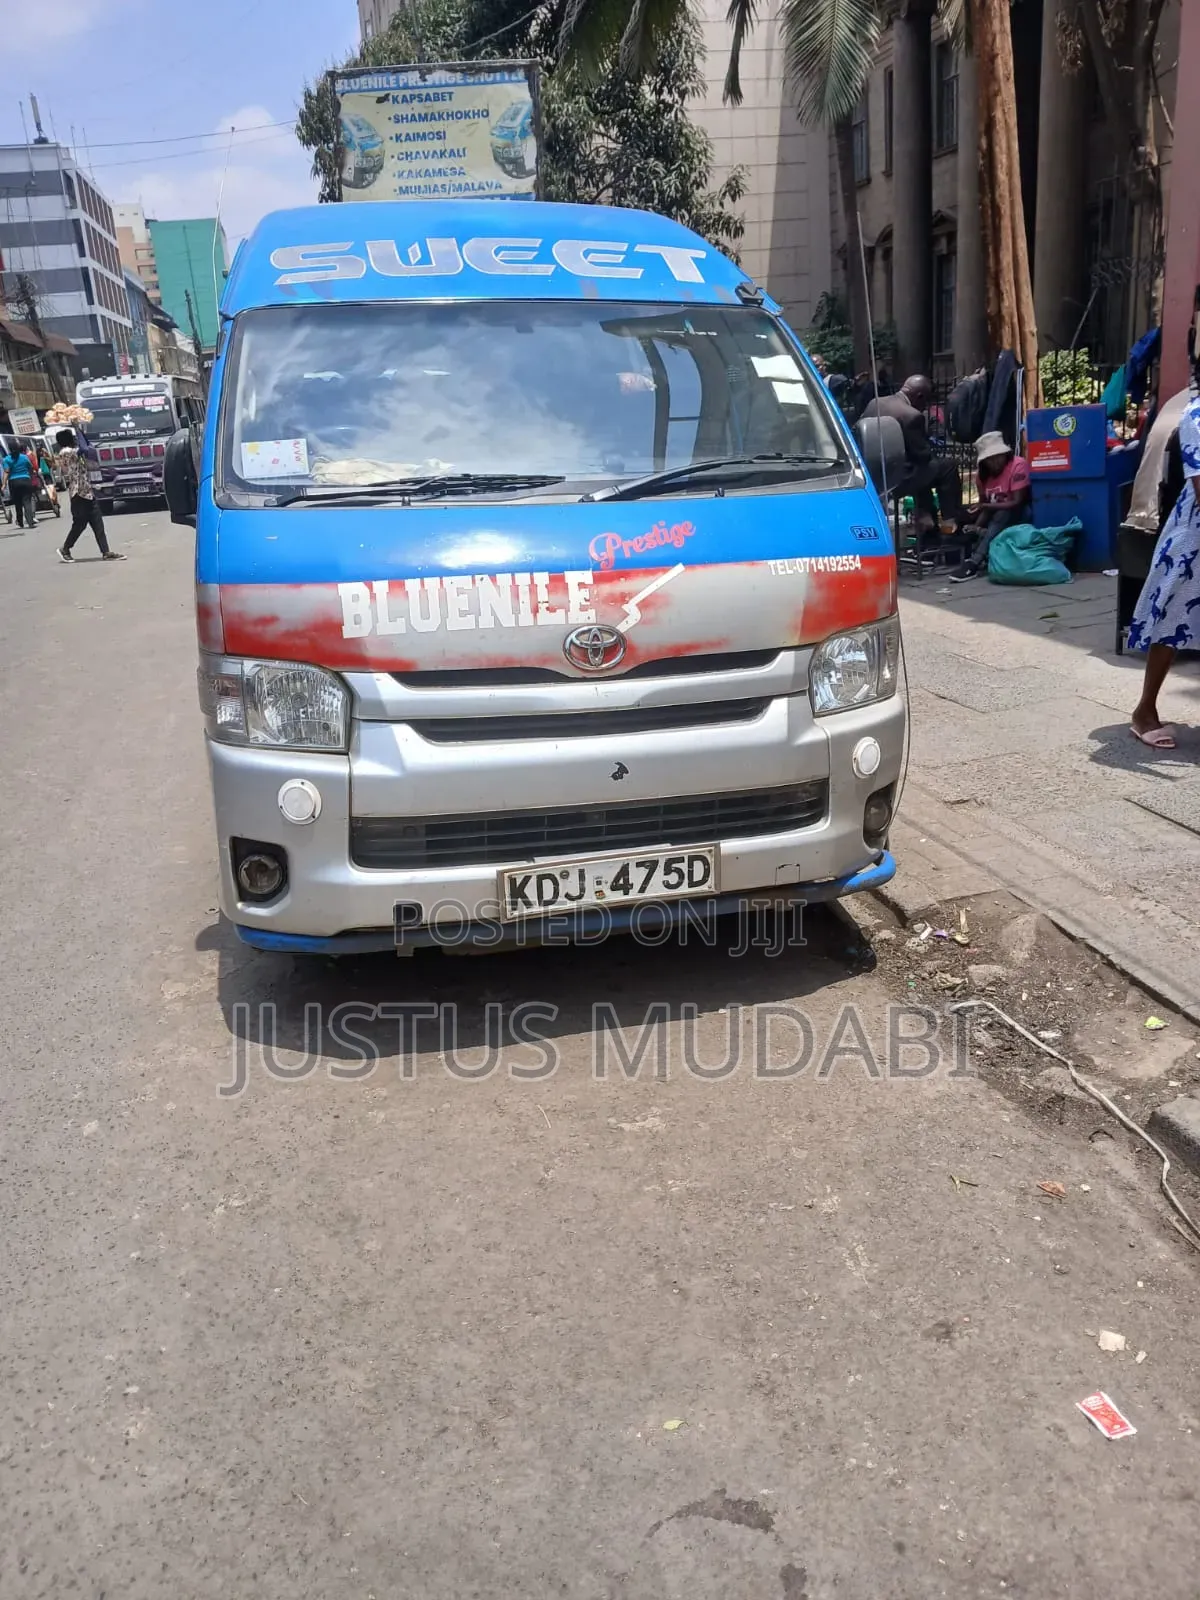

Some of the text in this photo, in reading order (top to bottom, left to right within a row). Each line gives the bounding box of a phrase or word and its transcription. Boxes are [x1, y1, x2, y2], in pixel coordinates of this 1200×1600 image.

[391, 91, 454, 105] KAPSABET
[393, 108, 489, 124] SHAMAKHOKHO
[395, 130, 447, 143] KAIMOSI
[397, 148, 466, 161] CHAVAKALI
[270, 237, 707, 286] SWEET
[853, 527, 877, 538] PSV
[589, 520, 696, 569] Prestige
[767, 554, 862, 576] TEL-0714192554
[337, 568, 598, 639] BLUENILE
[509, 854, 712, 912] KDJ 475D
